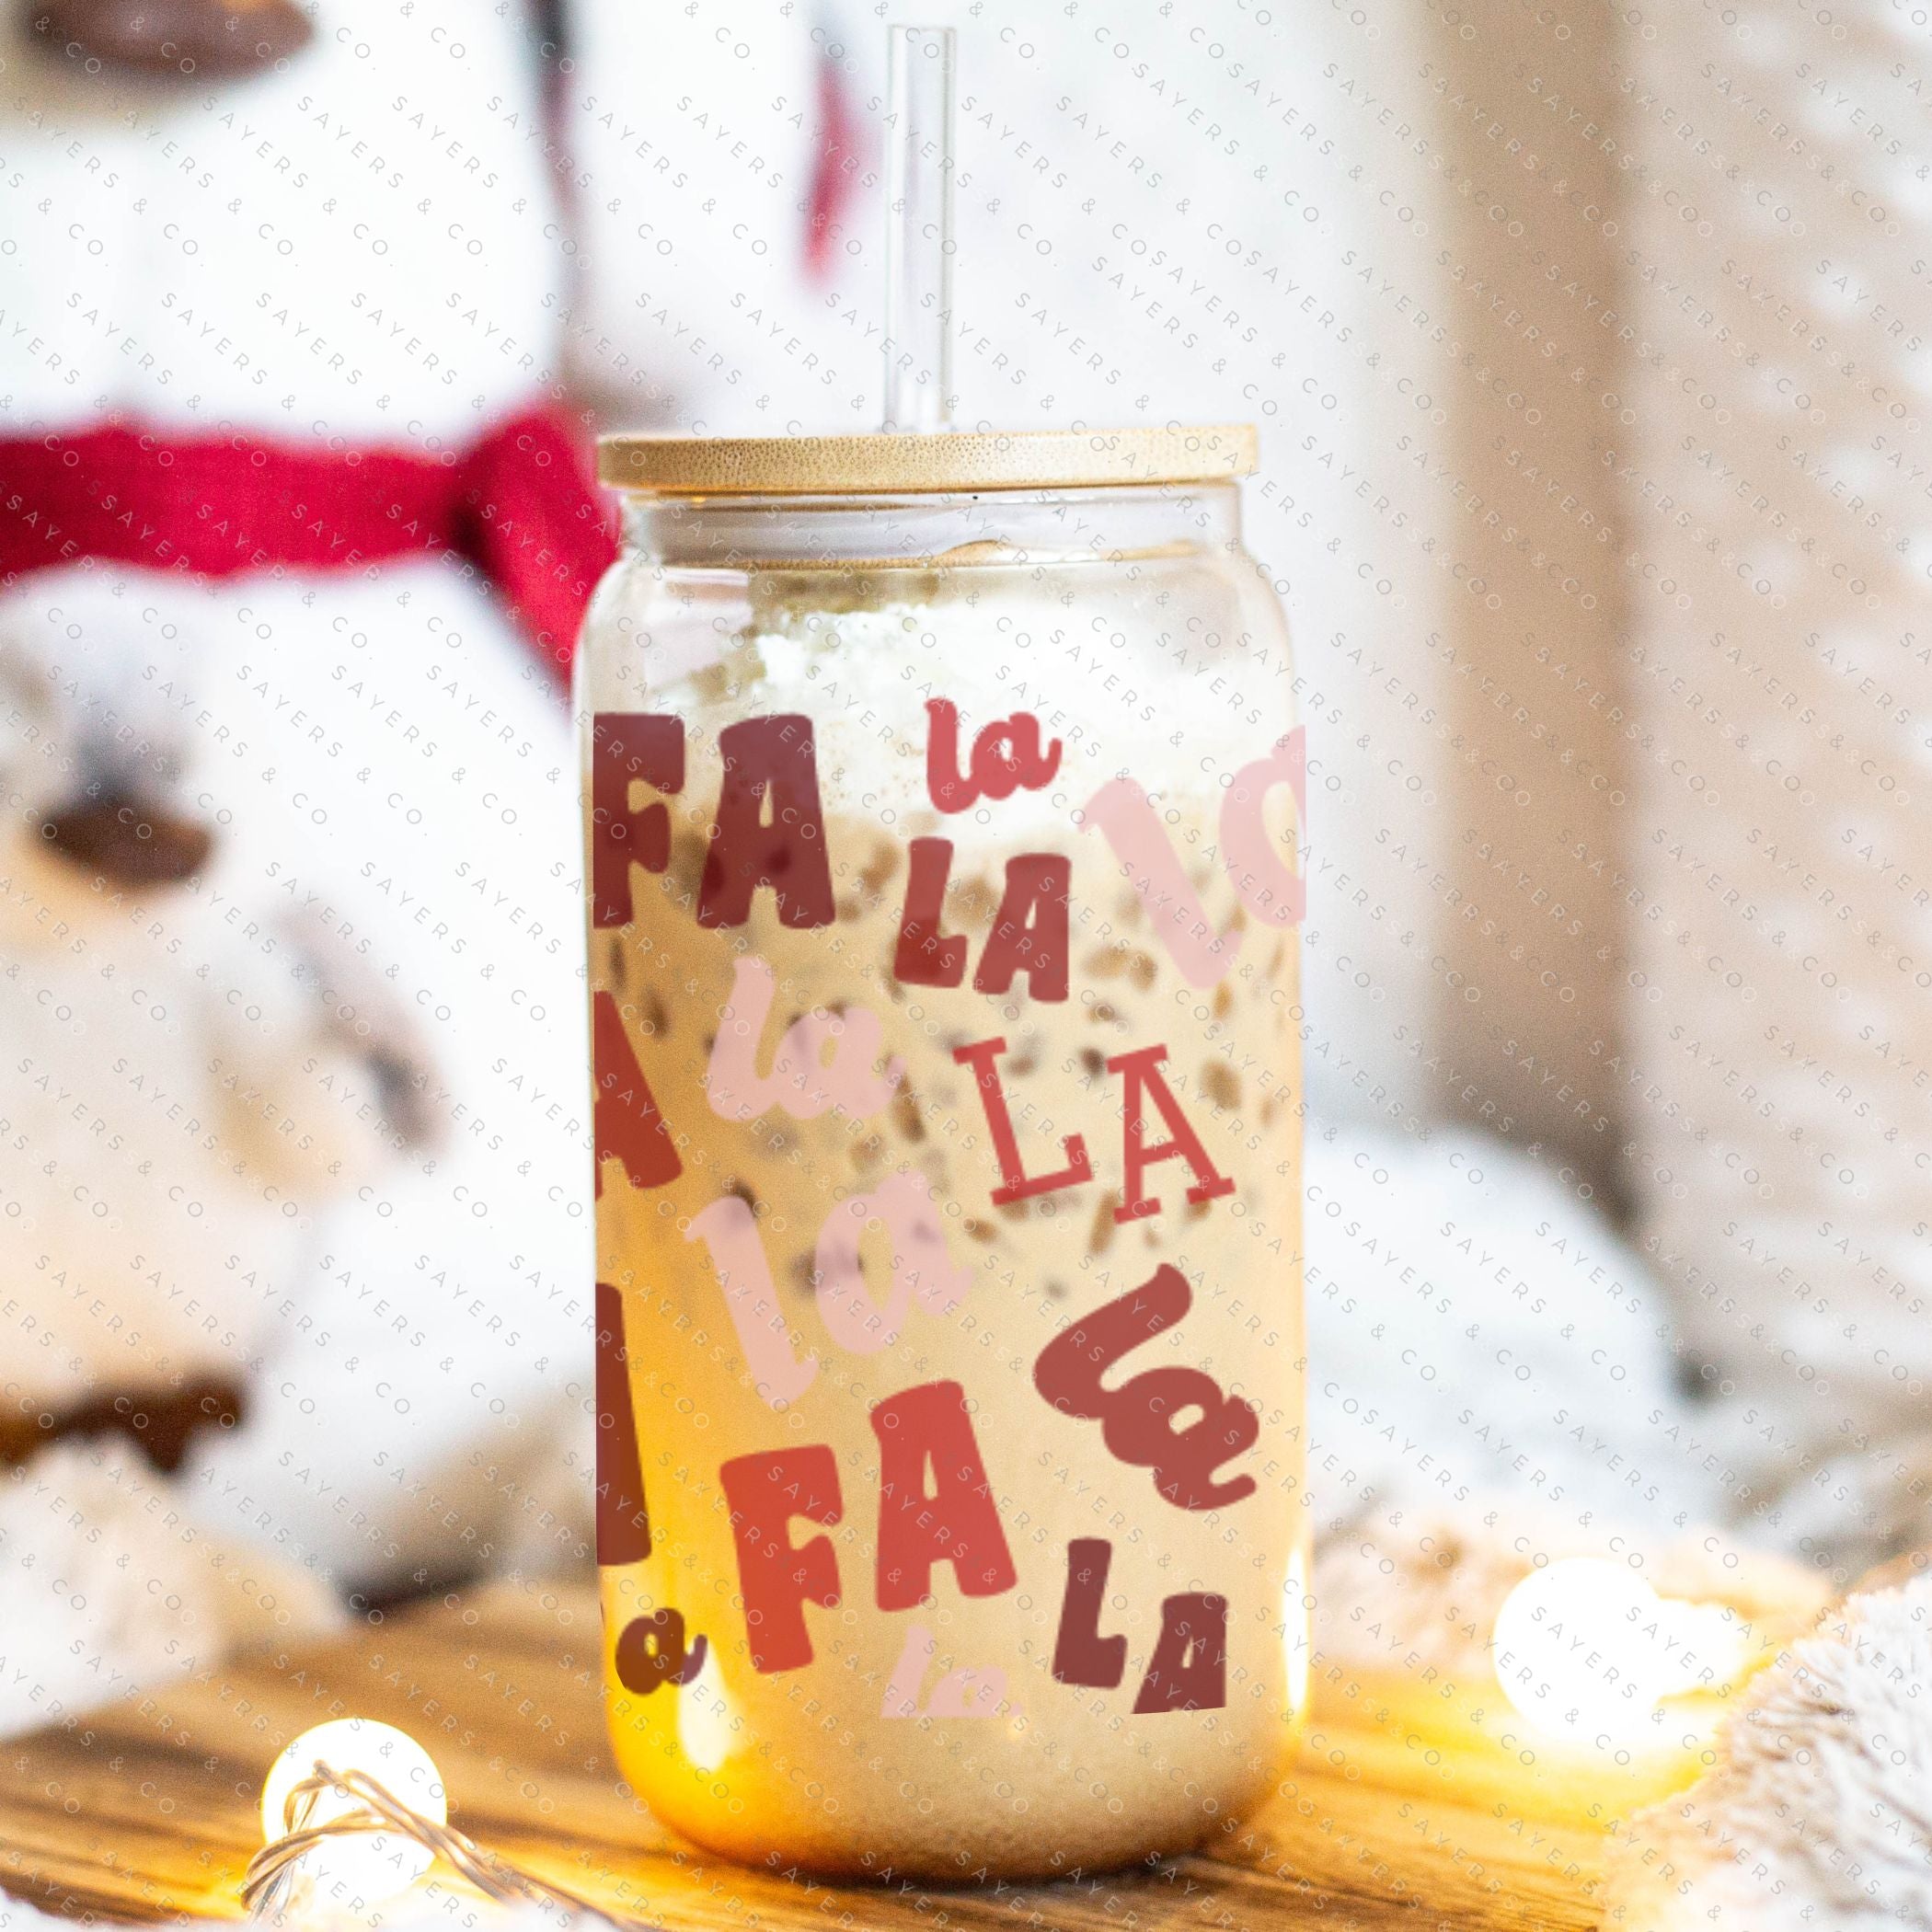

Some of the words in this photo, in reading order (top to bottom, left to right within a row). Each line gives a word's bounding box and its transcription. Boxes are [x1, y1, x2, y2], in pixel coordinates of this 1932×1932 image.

[593, 711, 837, 929] FA
[923, 696, 1064, 814] la
[892, 835, 1073, 1003] LA
[705, 955, 907, 1121] la
[952, 1036, 1236, 1225] LA
[683, 1169, 976, 1412] la
[719, 1378, 1018, 1675] FA
[1051, 1536, 1228, 1715] LA
